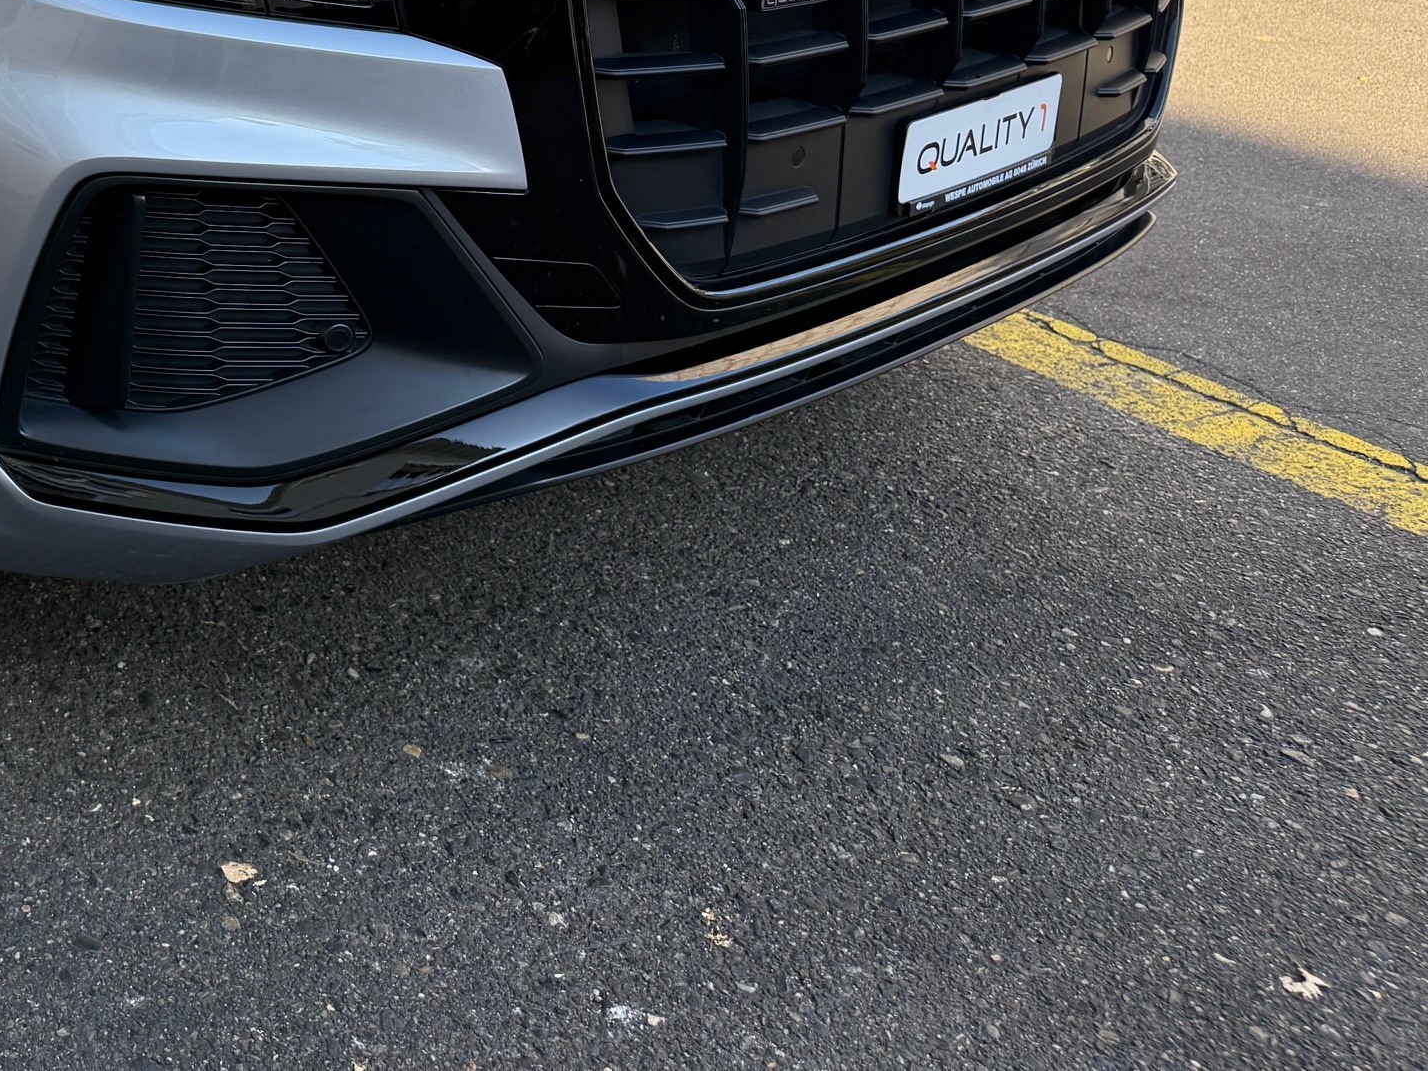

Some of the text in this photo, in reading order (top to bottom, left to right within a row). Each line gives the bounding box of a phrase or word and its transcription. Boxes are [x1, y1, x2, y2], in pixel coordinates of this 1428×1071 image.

[917, 103, 1048, 175] QUALITY 1
[967, 173, 1006, 195] AUTOMOBILE
